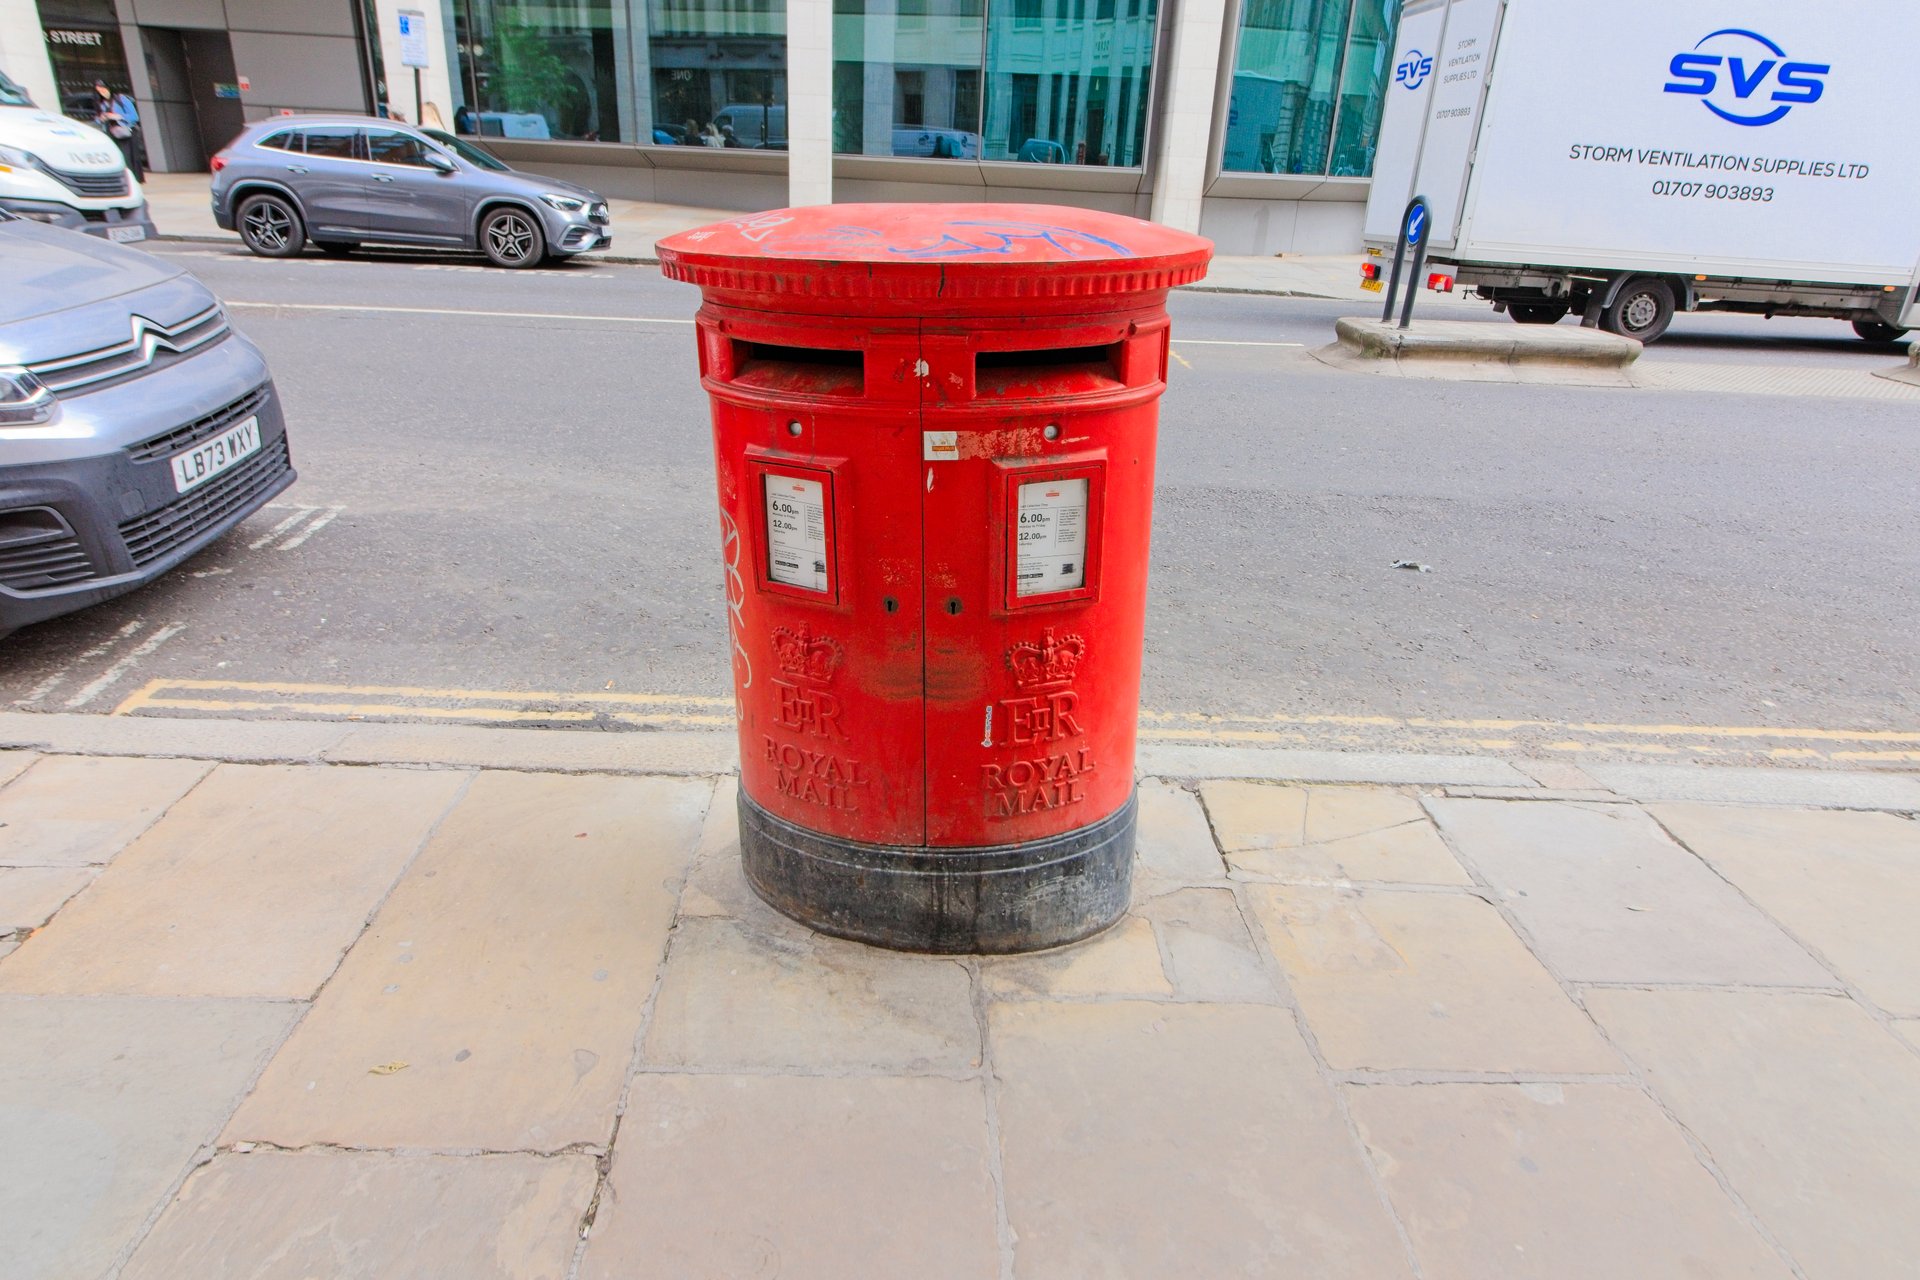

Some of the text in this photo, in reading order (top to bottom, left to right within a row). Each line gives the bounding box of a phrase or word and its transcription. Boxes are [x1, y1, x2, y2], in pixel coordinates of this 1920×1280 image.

[50, 30, 102, 46] STREET
[1458, 38, 1476, 50] STORM
[1395, 57, 1433, 82] SVS
[1664, 53, 1831, 104] SVS
[1569, 144, 1869, 180] STORM VENTILATION SUPPLIES LTD
[1652, 180, 1774, 202] 01707 903893
[181, 423, 253, 483] LB73 WXY
[772, 500, 799, 515] 6.00pm
[1020, 512, 1050, 523] 6.00pm
[772, 519, 797, 531] 12.00pm
[1018, 532, 1046, 541] 12.00pm
[763, 734, 869, 784] ROYAL
[981, 747, 1097, 789] ROYAL
[774, 767, 859, 811] MAIL
[995, 778, 1086, 816] MAIL
